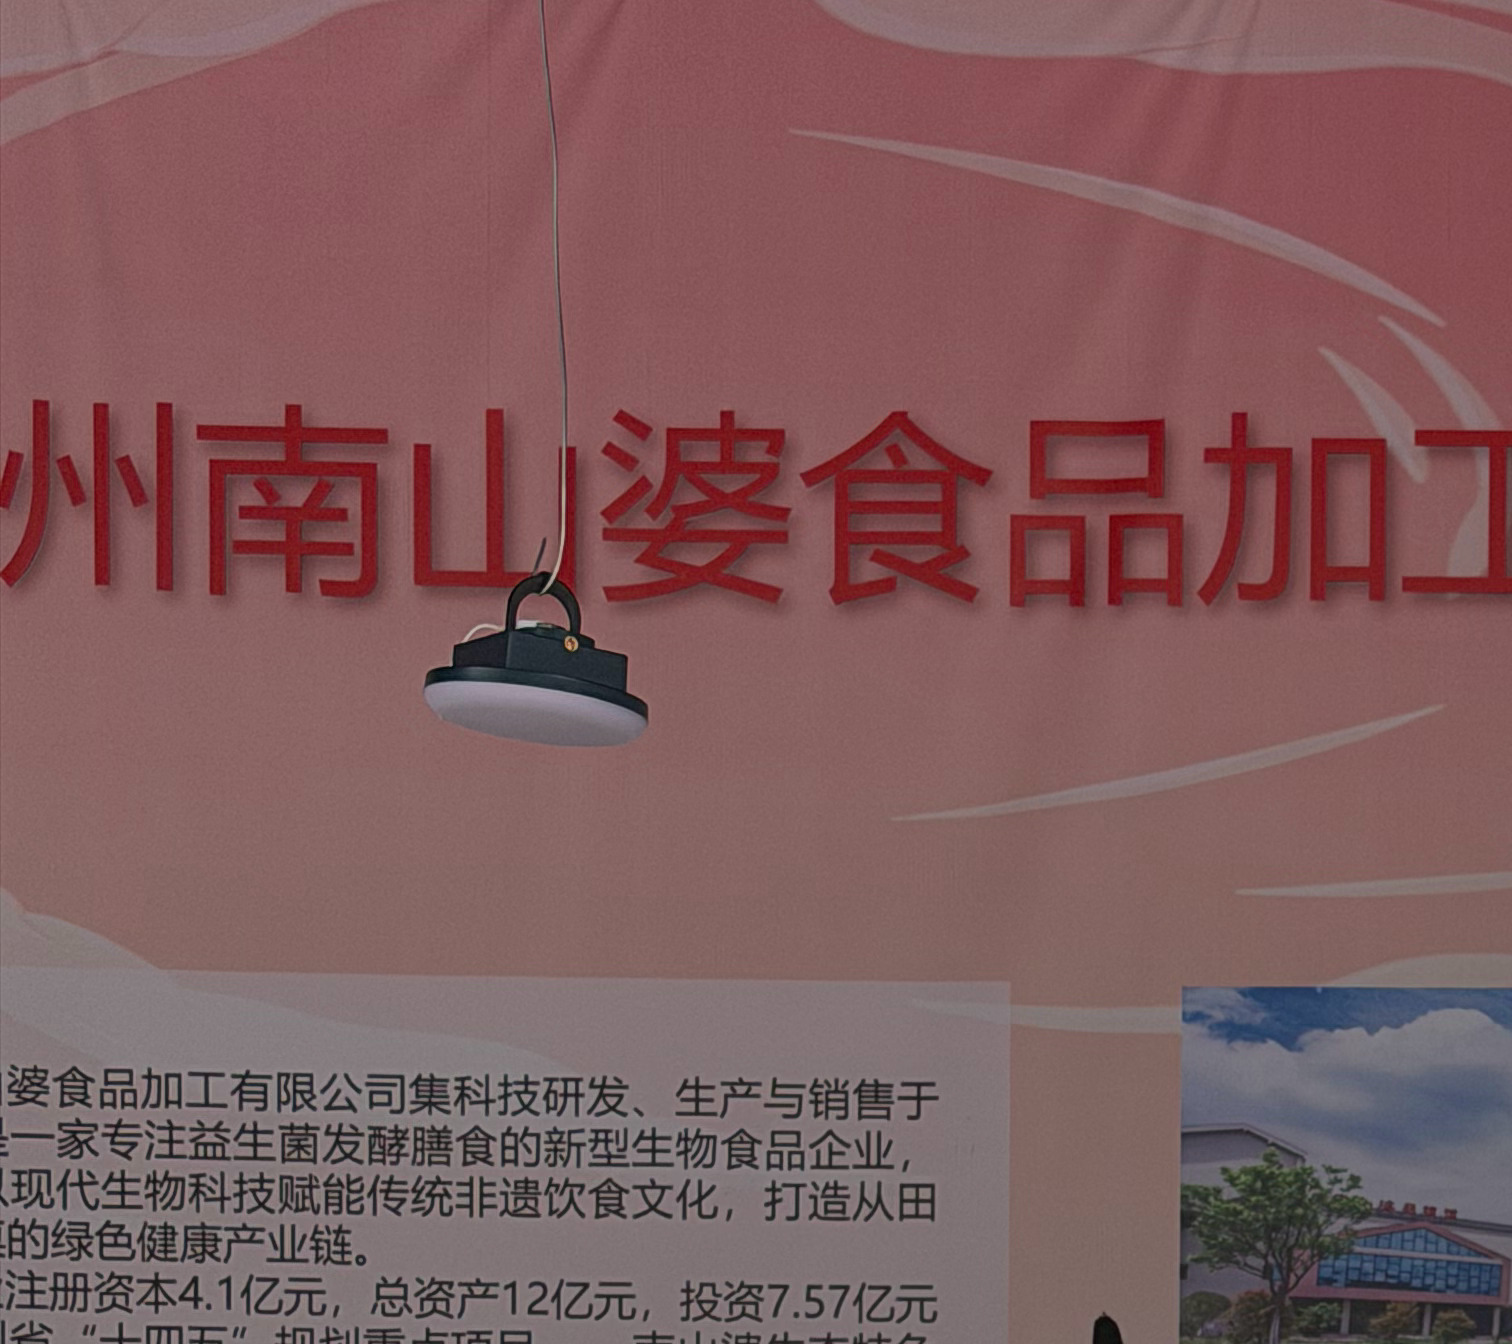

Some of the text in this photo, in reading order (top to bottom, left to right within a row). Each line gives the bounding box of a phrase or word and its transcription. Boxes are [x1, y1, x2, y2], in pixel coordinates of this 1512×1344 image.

[0, 1064, 940, 1122] 婆食品加工有限公司集科技研发、生产与销售于
[0, 1118, 912, 1175] 一家专注益生菌发酵膳食的新型生物食品企业，
[0, 1168, 937, 1223] 现代生物科技赋能传统非遗饮食文化，打造从田
[0, 1217, 368, 1268] 的绿色健康产业链。
[0, 1269, 940, 1325] 注册资本4.1亿元，总资产12亿元，投资7.57亿元
